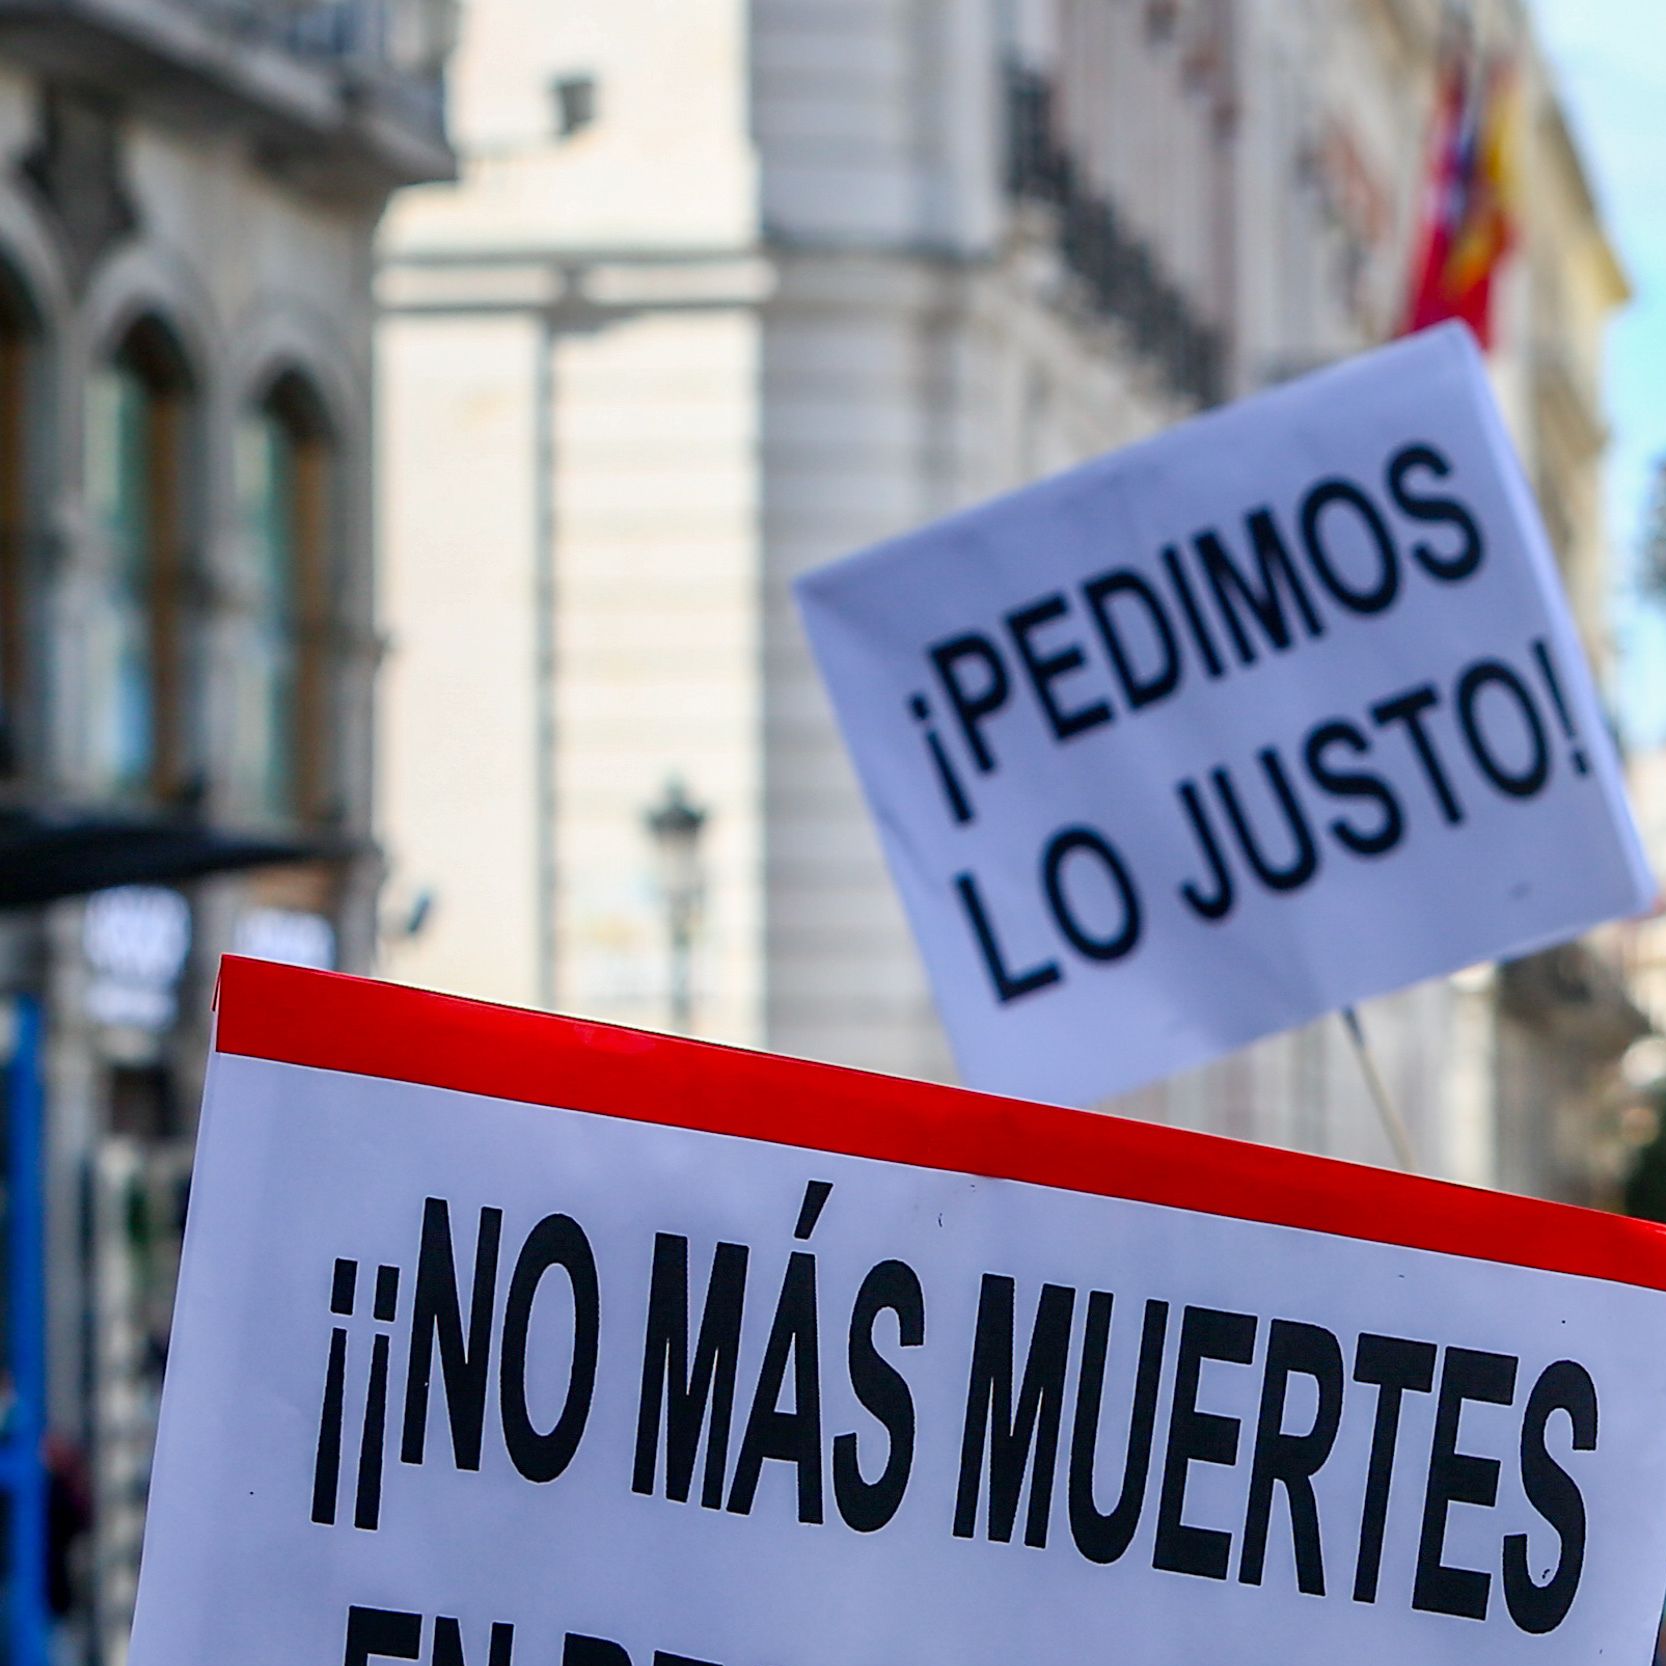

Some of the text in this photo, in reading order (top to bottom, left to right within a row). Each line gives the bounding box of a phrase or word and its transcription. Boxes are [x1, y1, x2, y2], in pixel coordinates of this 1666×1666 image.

[908, 442, 1486, 825] ¡PEDIMOS
[954, 638, 1590, 1007] LO JUSTO!
[311, 1180, 1598, 1634] ¡¡NO MÁS MUERTES
